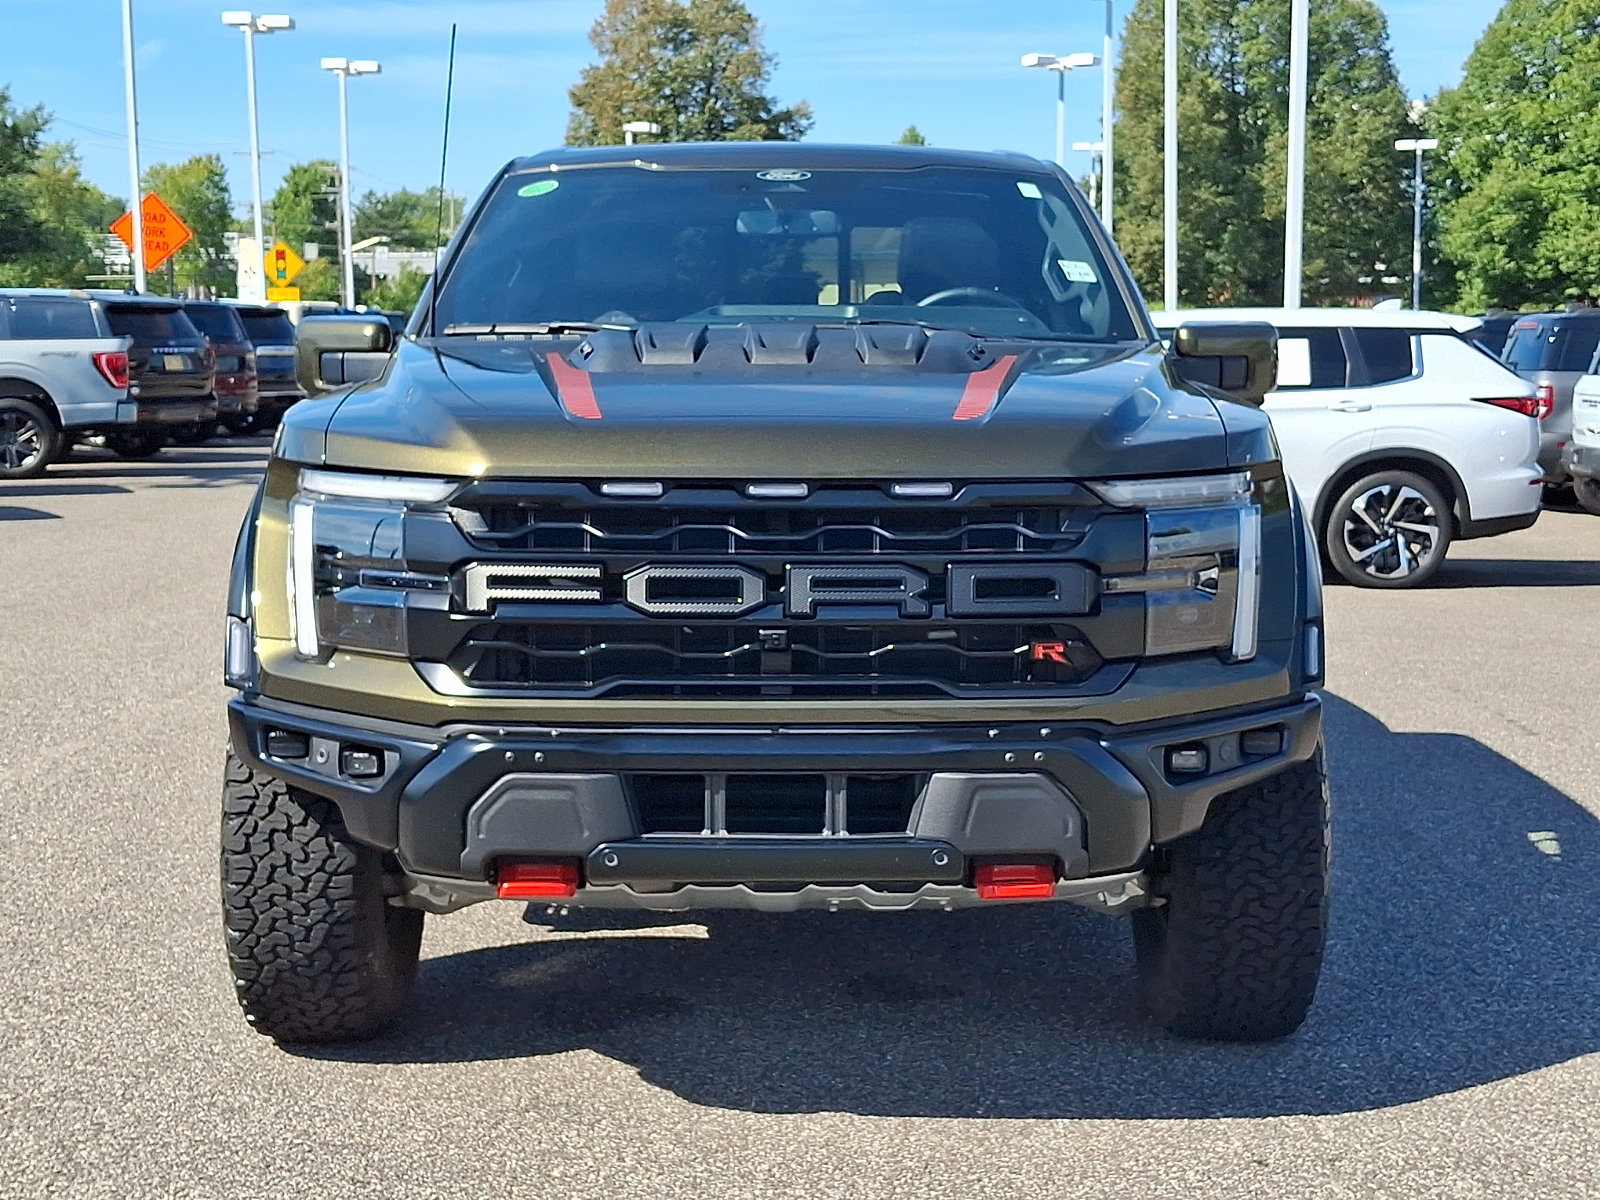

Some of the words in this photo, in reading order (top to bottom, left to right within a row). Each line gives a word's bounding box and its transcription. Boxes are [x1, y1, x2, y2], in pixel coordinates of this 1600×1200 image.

[144, 212, 166, 223] OAD
[144, 226, 166, 238] ORK
[144, 240, 169, 251] EAD
[463, 561, 1097, 619] FORD
[1033, 641, 1069, 664] R
